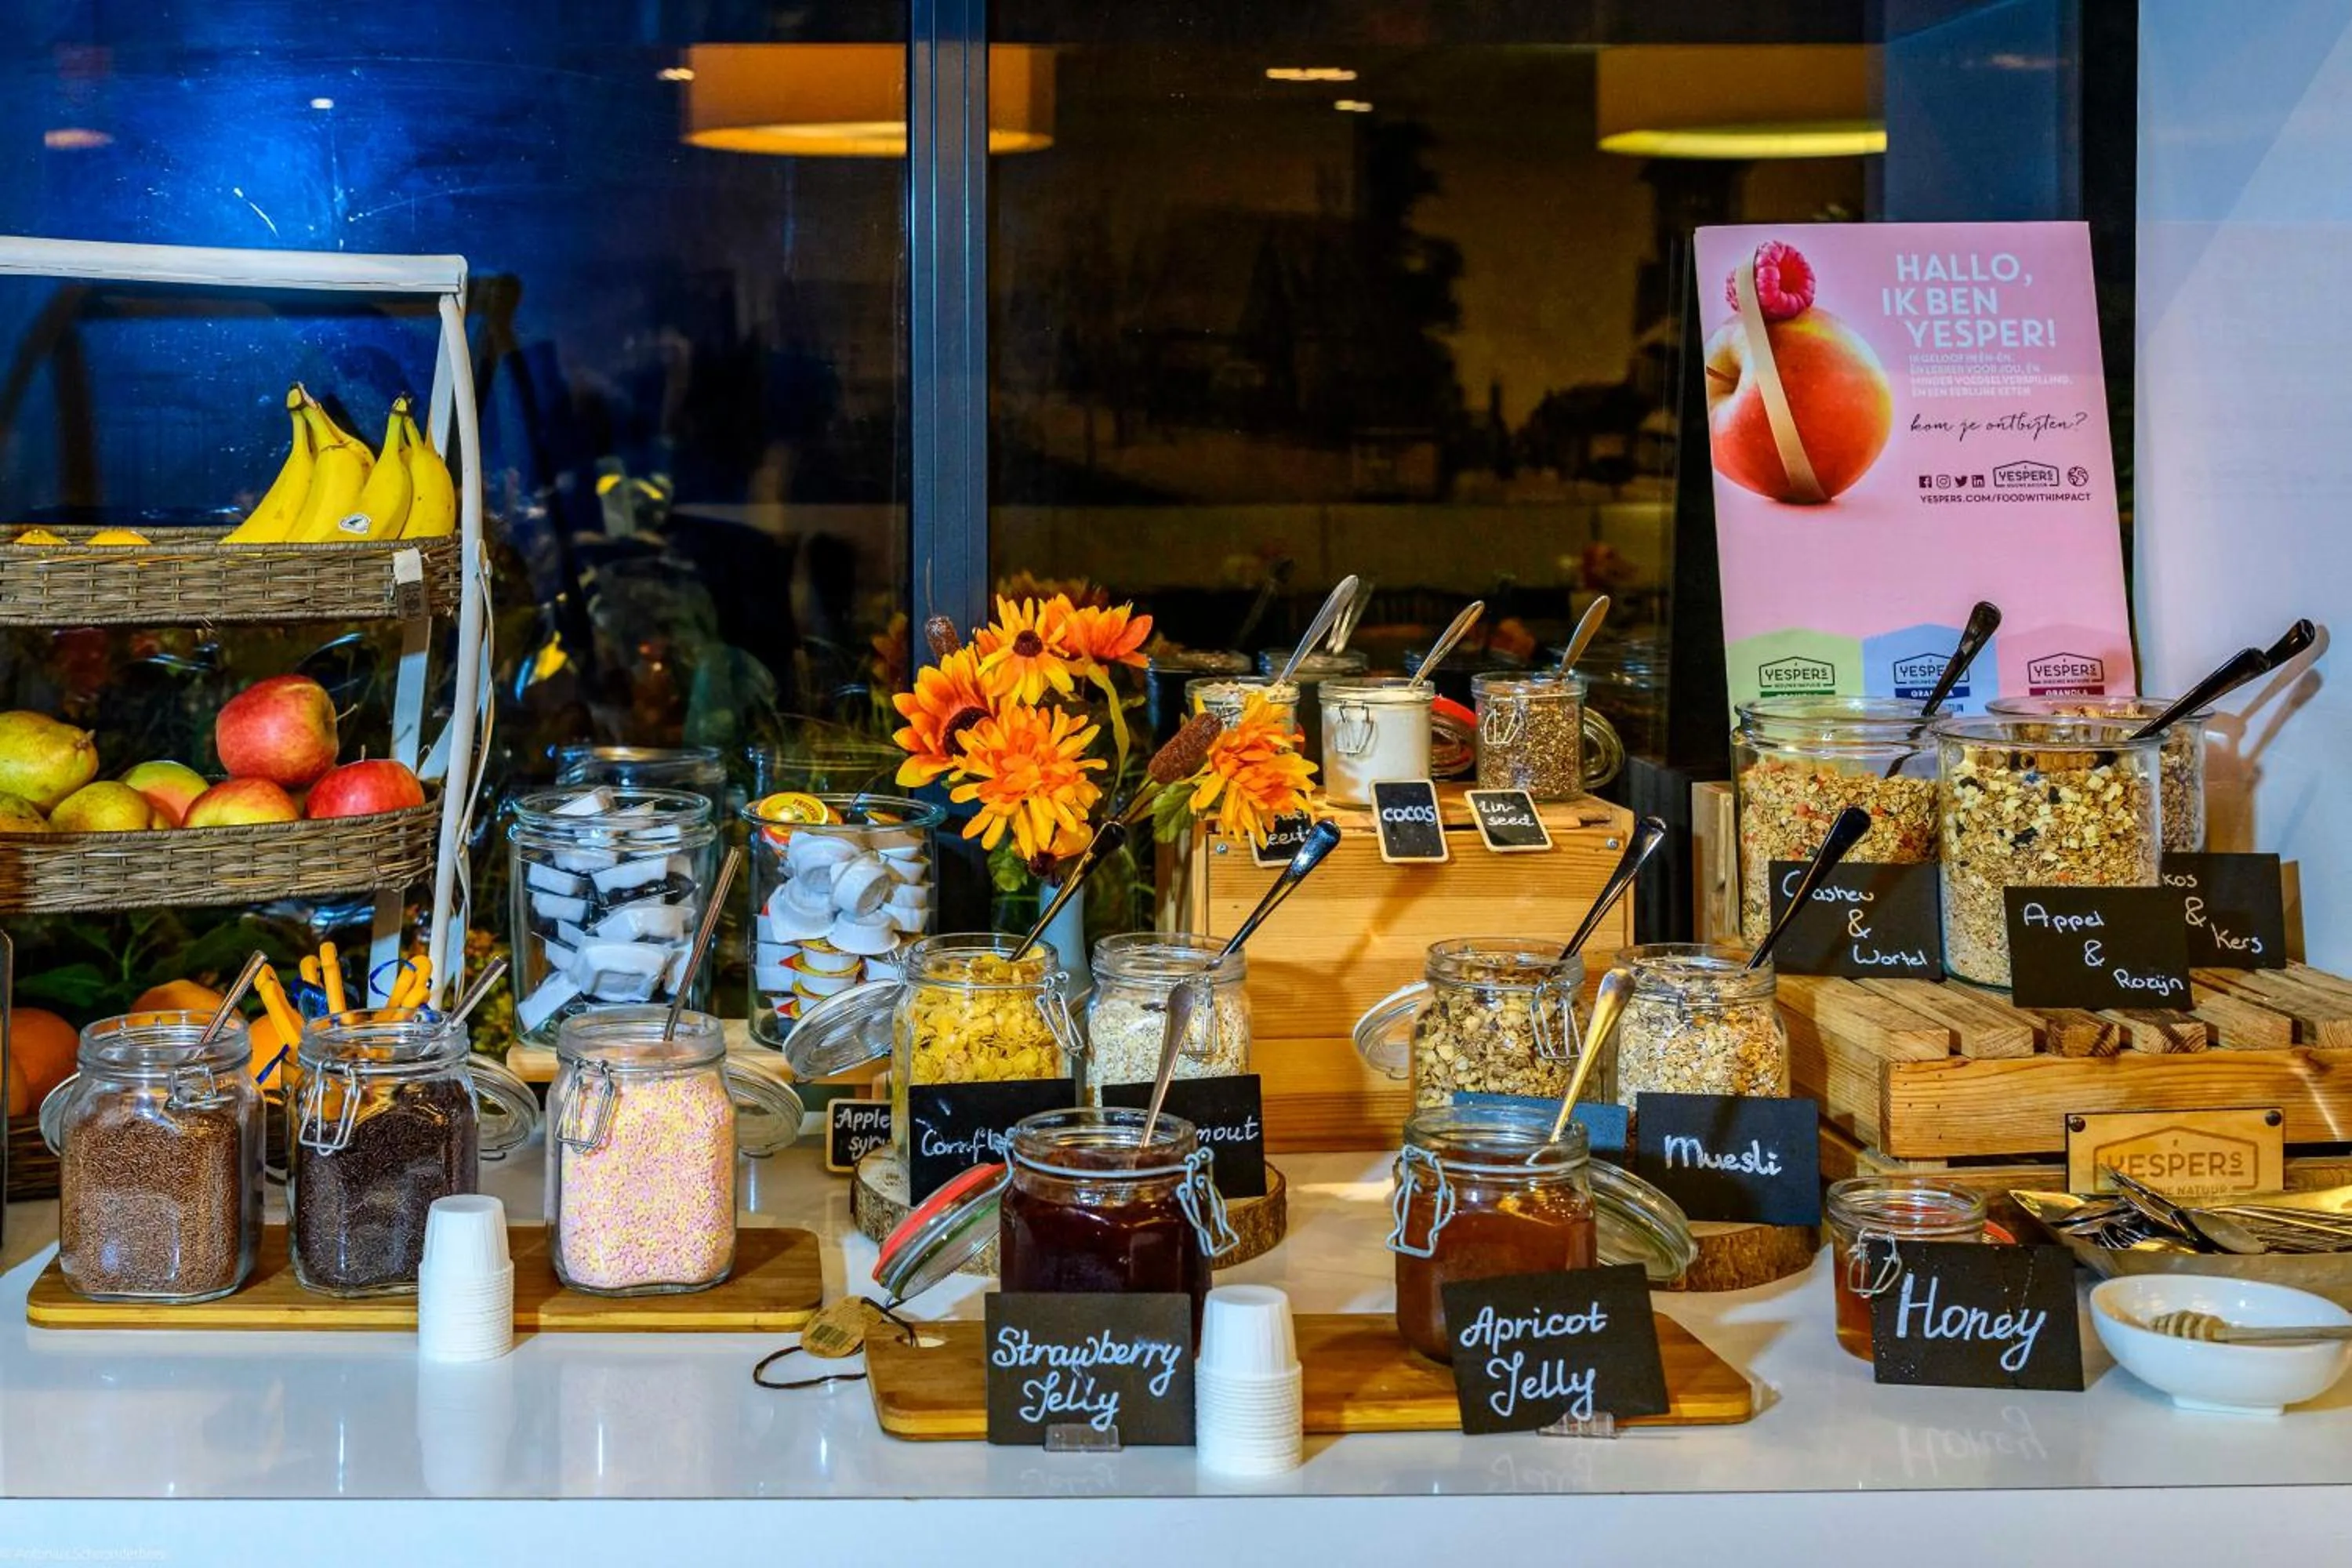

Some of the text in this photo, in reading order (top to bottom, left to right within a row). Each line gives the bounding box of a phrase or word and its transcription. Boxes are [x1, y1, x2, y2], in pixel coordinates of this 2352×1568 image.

[1896, 252, 2033, 287] HALLO,
[1882, 286, 1998, 315] IK BEN
[1904, 318, 2056, 348] YESPER!
[1911, 413, 1953, 431] kom
[1959, 417, 1980, 442] je
[1998, 470, 2053, 481] YESPERS
[1920, 492, 2092, 504] YESPERS.COM/FOODWITHIMPACT
[1765, 668, 1828, 681] YESPERS
[1900, 665, 1945, 677] YESPE
[2034, 663, 2096, 677] YESPERS
[1848, 908, 1871, 938] &
[2023, 902, 2105, 933] Appel
[2185, 896, 2207, 927] &
[2210, 922, 2263, 954] Kers
[1852, 944, 1928, 966] Wortel
[2085, 939, 2105, 967] &
[834, 1107, 891, 1131] Apple
[848, 1134, 886, 1161] syr
[1664, 1134, 1782, 1176] Muesli
[2106, 1150, 2245, 1178] YESPERS
[1460, 1301, 1607, 1354] Apricot
[1895, 1272, 2047, 1372] Honey
[991, 1325, 1182, 1397] Strawberry
[1486, 1351, 1596, 1421] Jelly
[1019, 1370, 1120, 1432] Jelly
